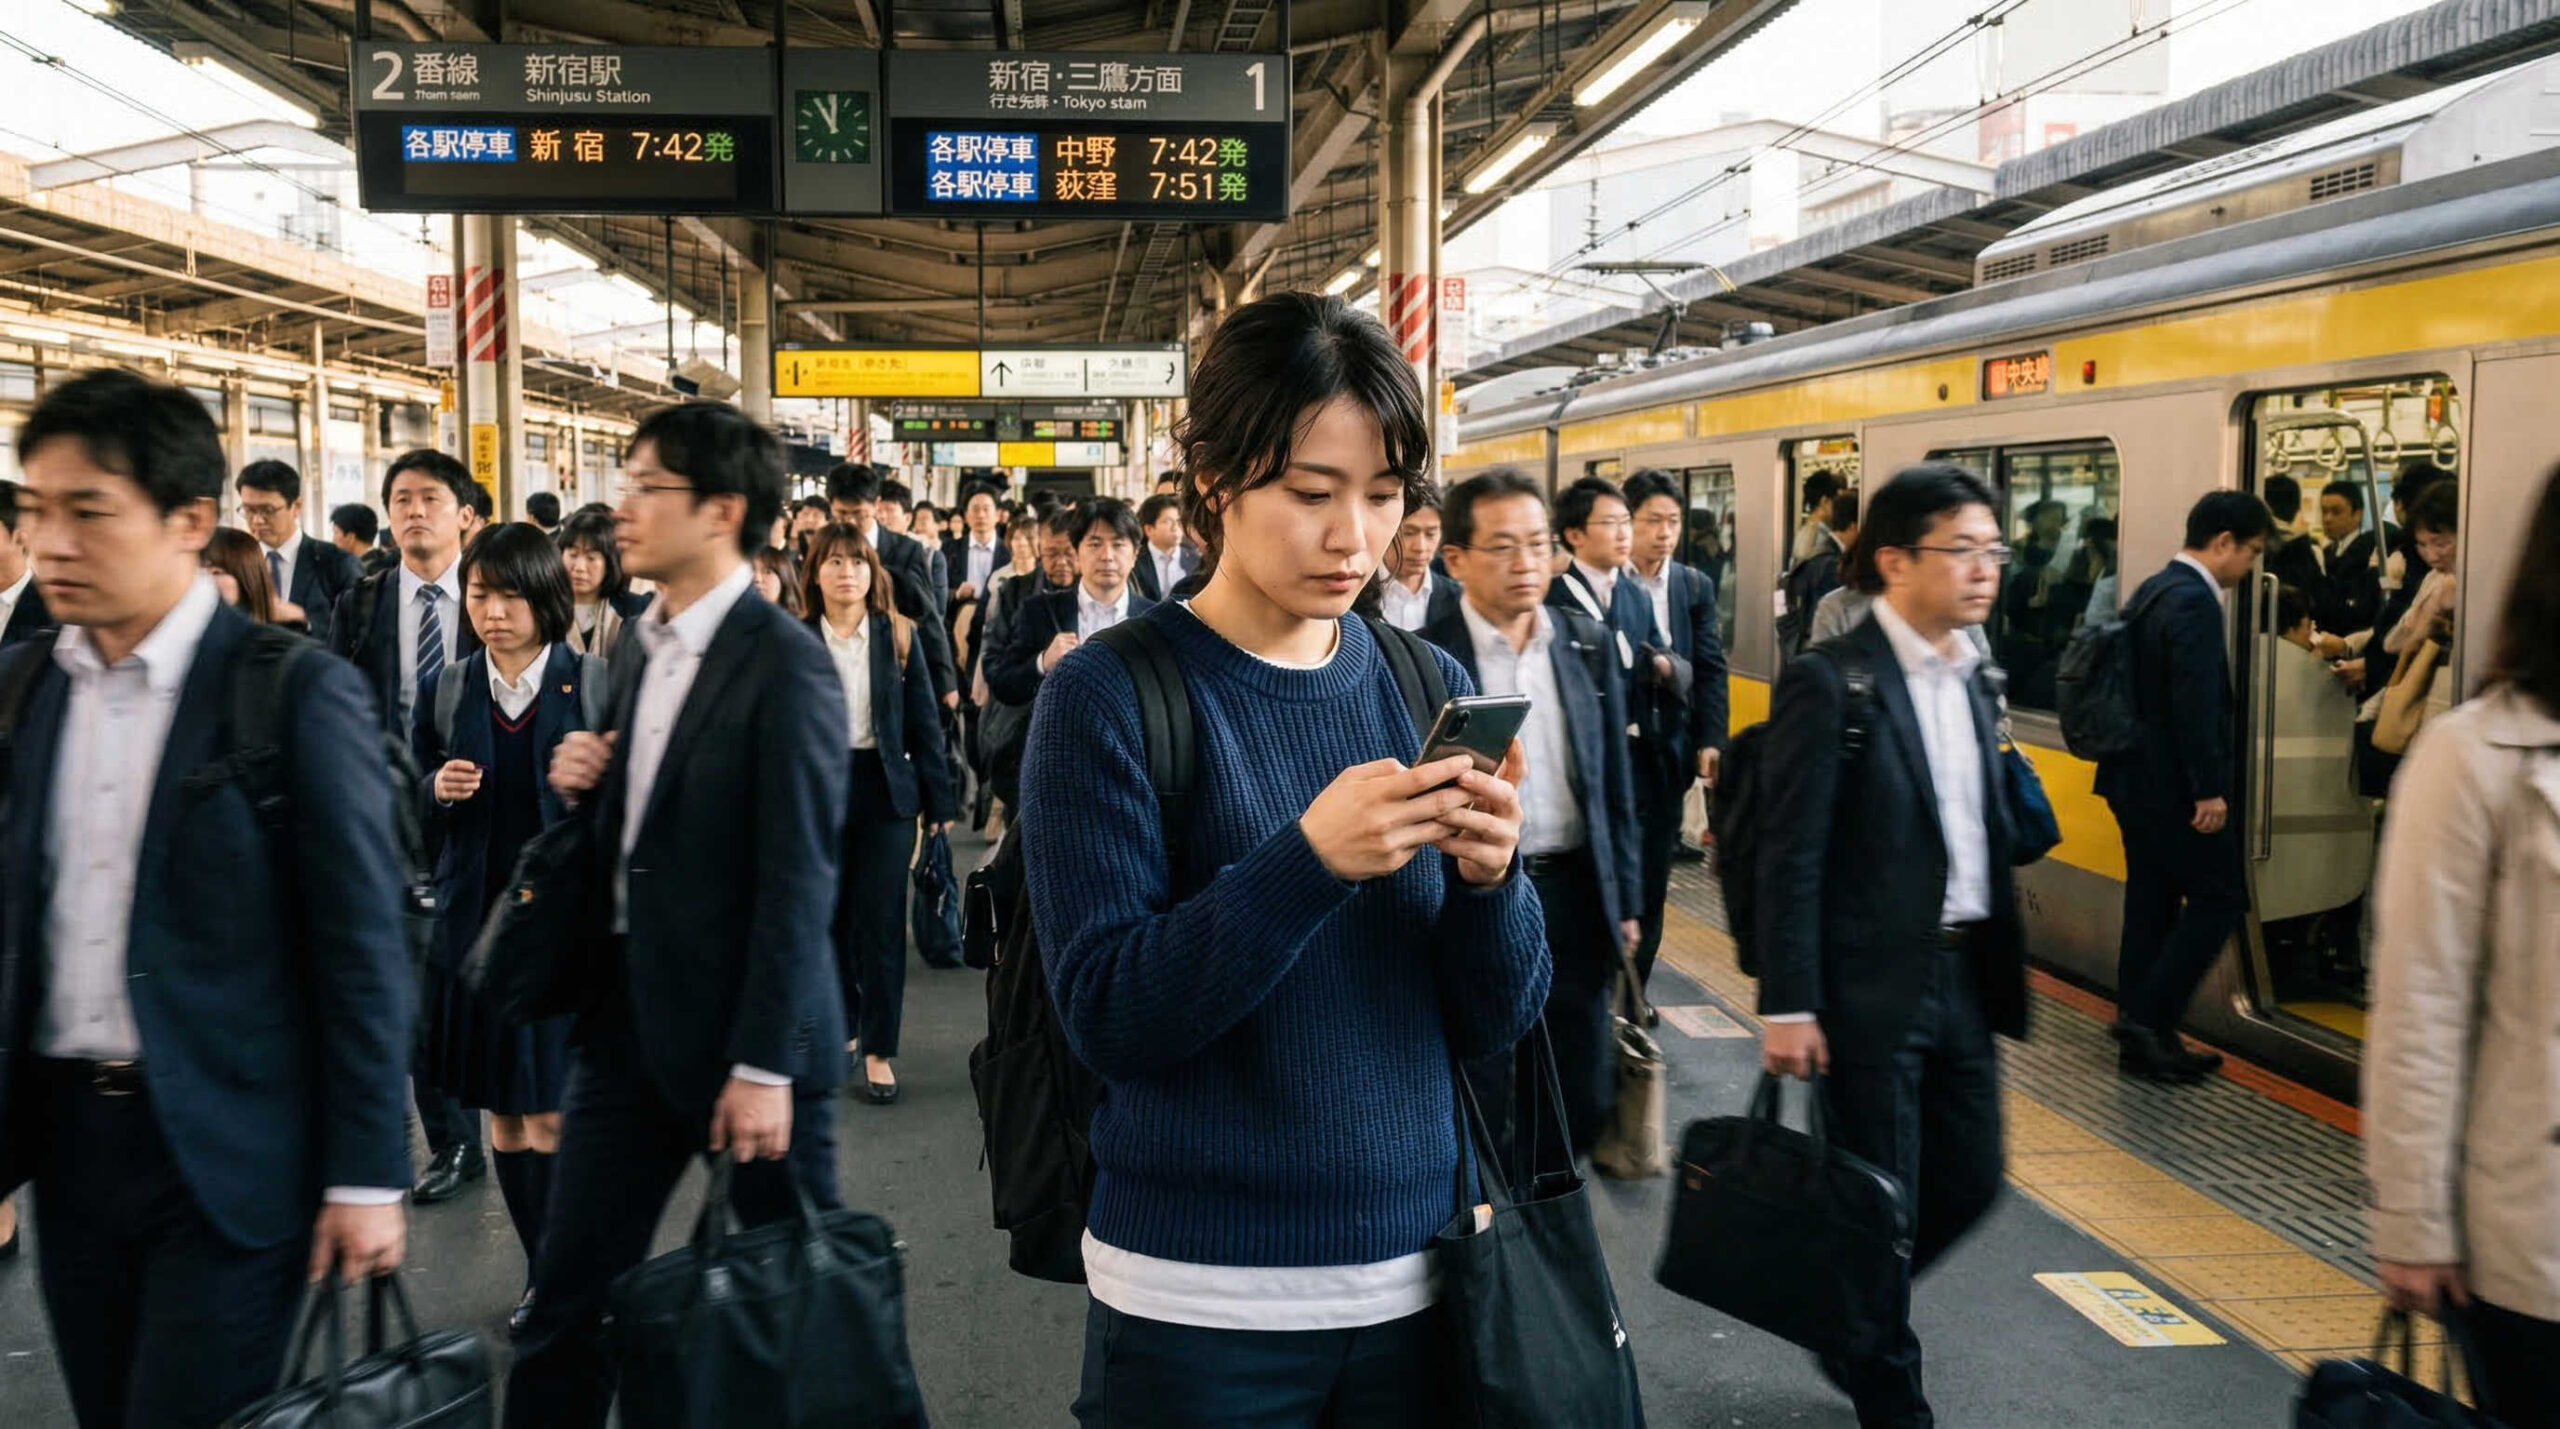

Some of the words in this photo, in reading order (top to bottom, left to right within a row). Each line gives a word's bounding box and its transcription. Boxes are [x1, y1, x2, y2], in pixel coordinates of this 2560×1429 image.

[372, 51, 404, 100] 2
[413, 52, 479, 86] 番線
[525, 54, 622, 86] 新宿駅
[988, 60, 1182, 93] 新宿・三鷹方面
[1245, 62, 1266, 111] 1
[525, 88, 592, 105] Shinjusu
[596, 89, 651, 104] Station
[1061, 95, 1107, 112] Tokyo
[405, 129, 514, 160] 各駅停車
[530, 130, 604, 162] 新宿
[930, 136, 1035, 164] 各駅停車
[1056, 136, 1117, 166] 中野
[930, 170, 1035, 199] 各駅停車
[1056, 170, 1117, 201] 荻窪
